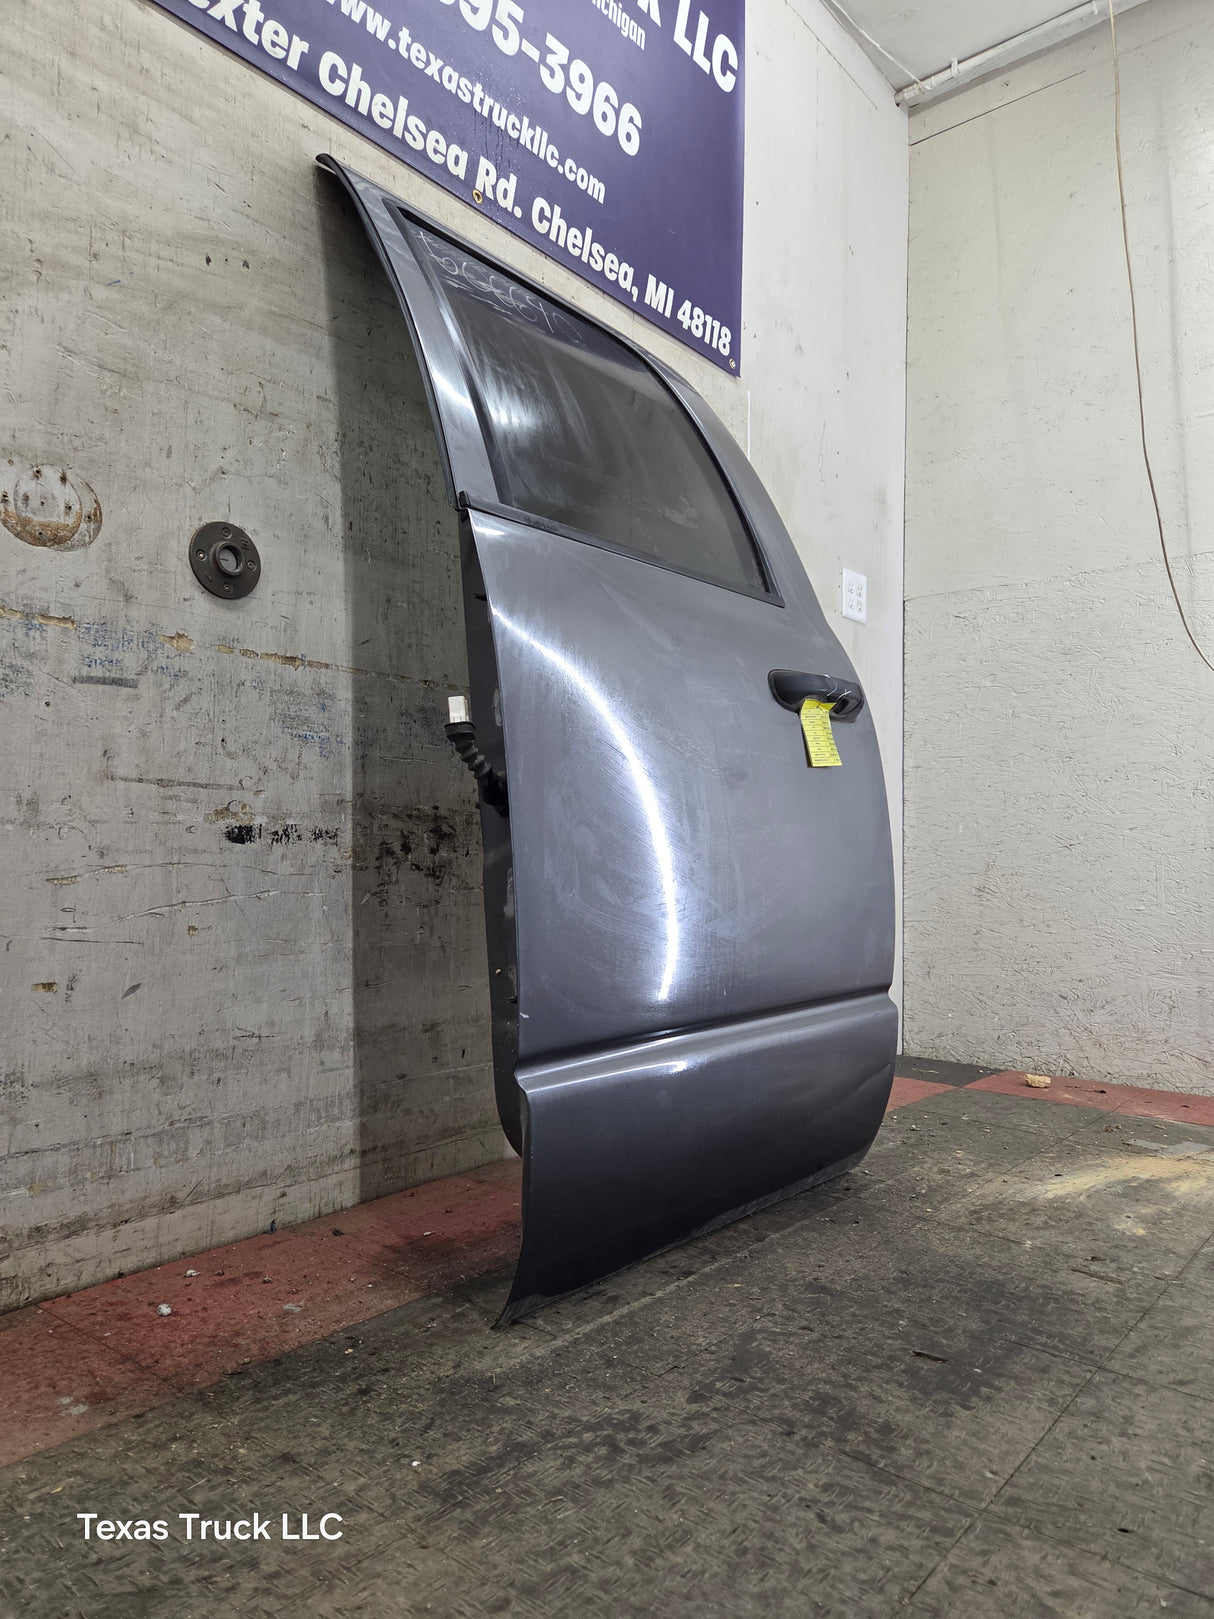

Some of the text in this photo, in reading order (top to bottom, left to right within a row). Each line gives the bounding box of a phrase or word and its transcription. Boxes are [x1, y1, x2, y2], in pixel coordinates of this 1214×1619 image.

[325, 0, 606, 203] ww.texastruckllc.com
[434, 0, 643, 156] 95-3966
[673, 0, 738, 92] LLC
[188, 0, 733, 358] xter Chelsea Rd. Chelsea, MI 48118
